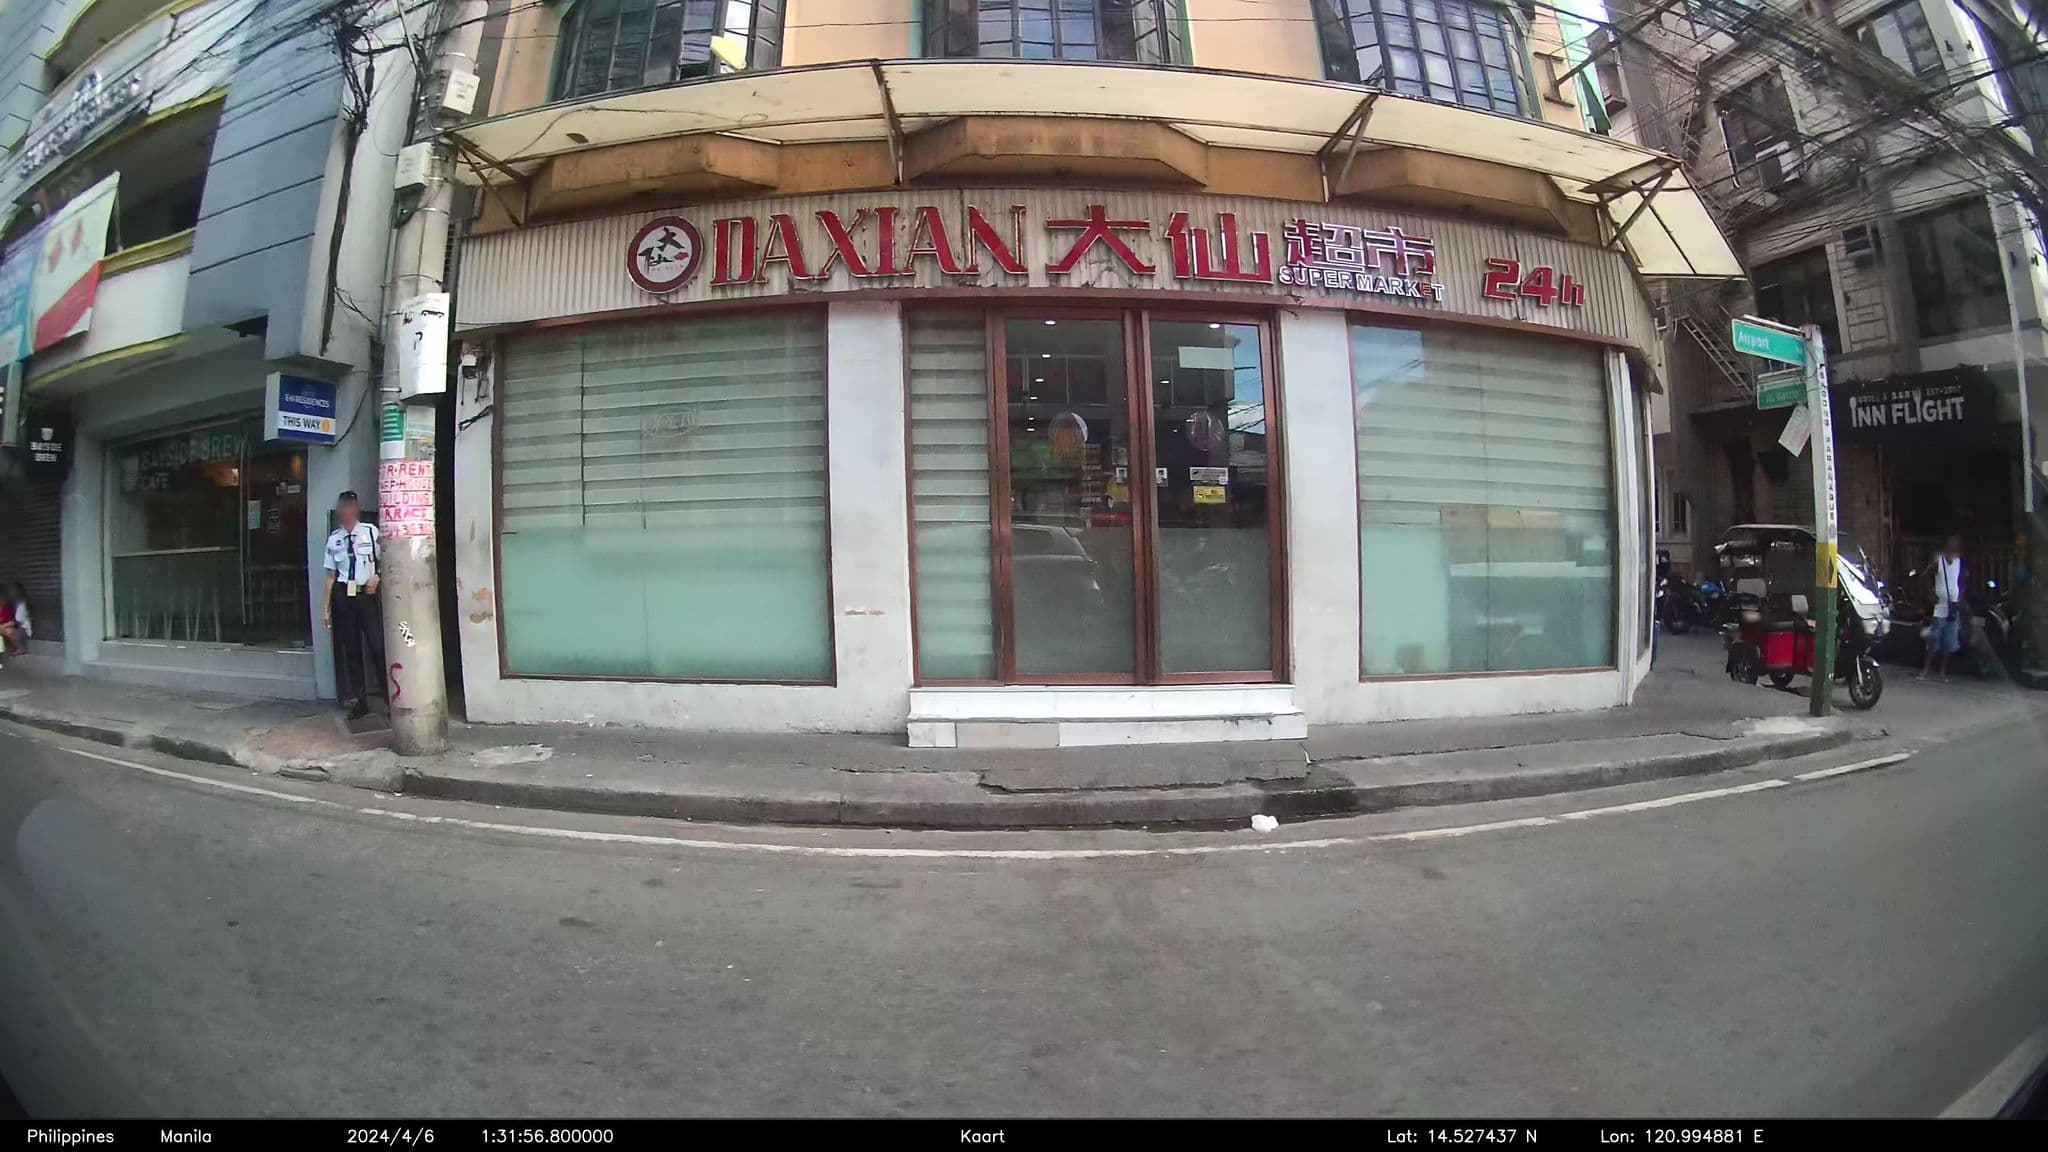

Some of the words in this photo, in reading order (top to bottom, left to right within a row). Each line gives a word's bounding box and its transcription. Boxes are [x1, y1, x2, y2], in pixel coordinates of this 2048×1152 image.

[710, 205, 1030, 287] DAXIAN
[1045, 204, 1273, 284] 大仙
[1284, 218, 1437, 276] 超市
[1279, 265, 1355, 290] SUPER
[1355, 274, 1445, 301] MARKET
[1484, 257, 1586, 308] 24h
[282, 415, 301, 428] THIS
[302, 418, 321, 429] WAY
[1849, 396, 1886, 428] INN
[1891, 387, 1965, 424] FLIGHT
